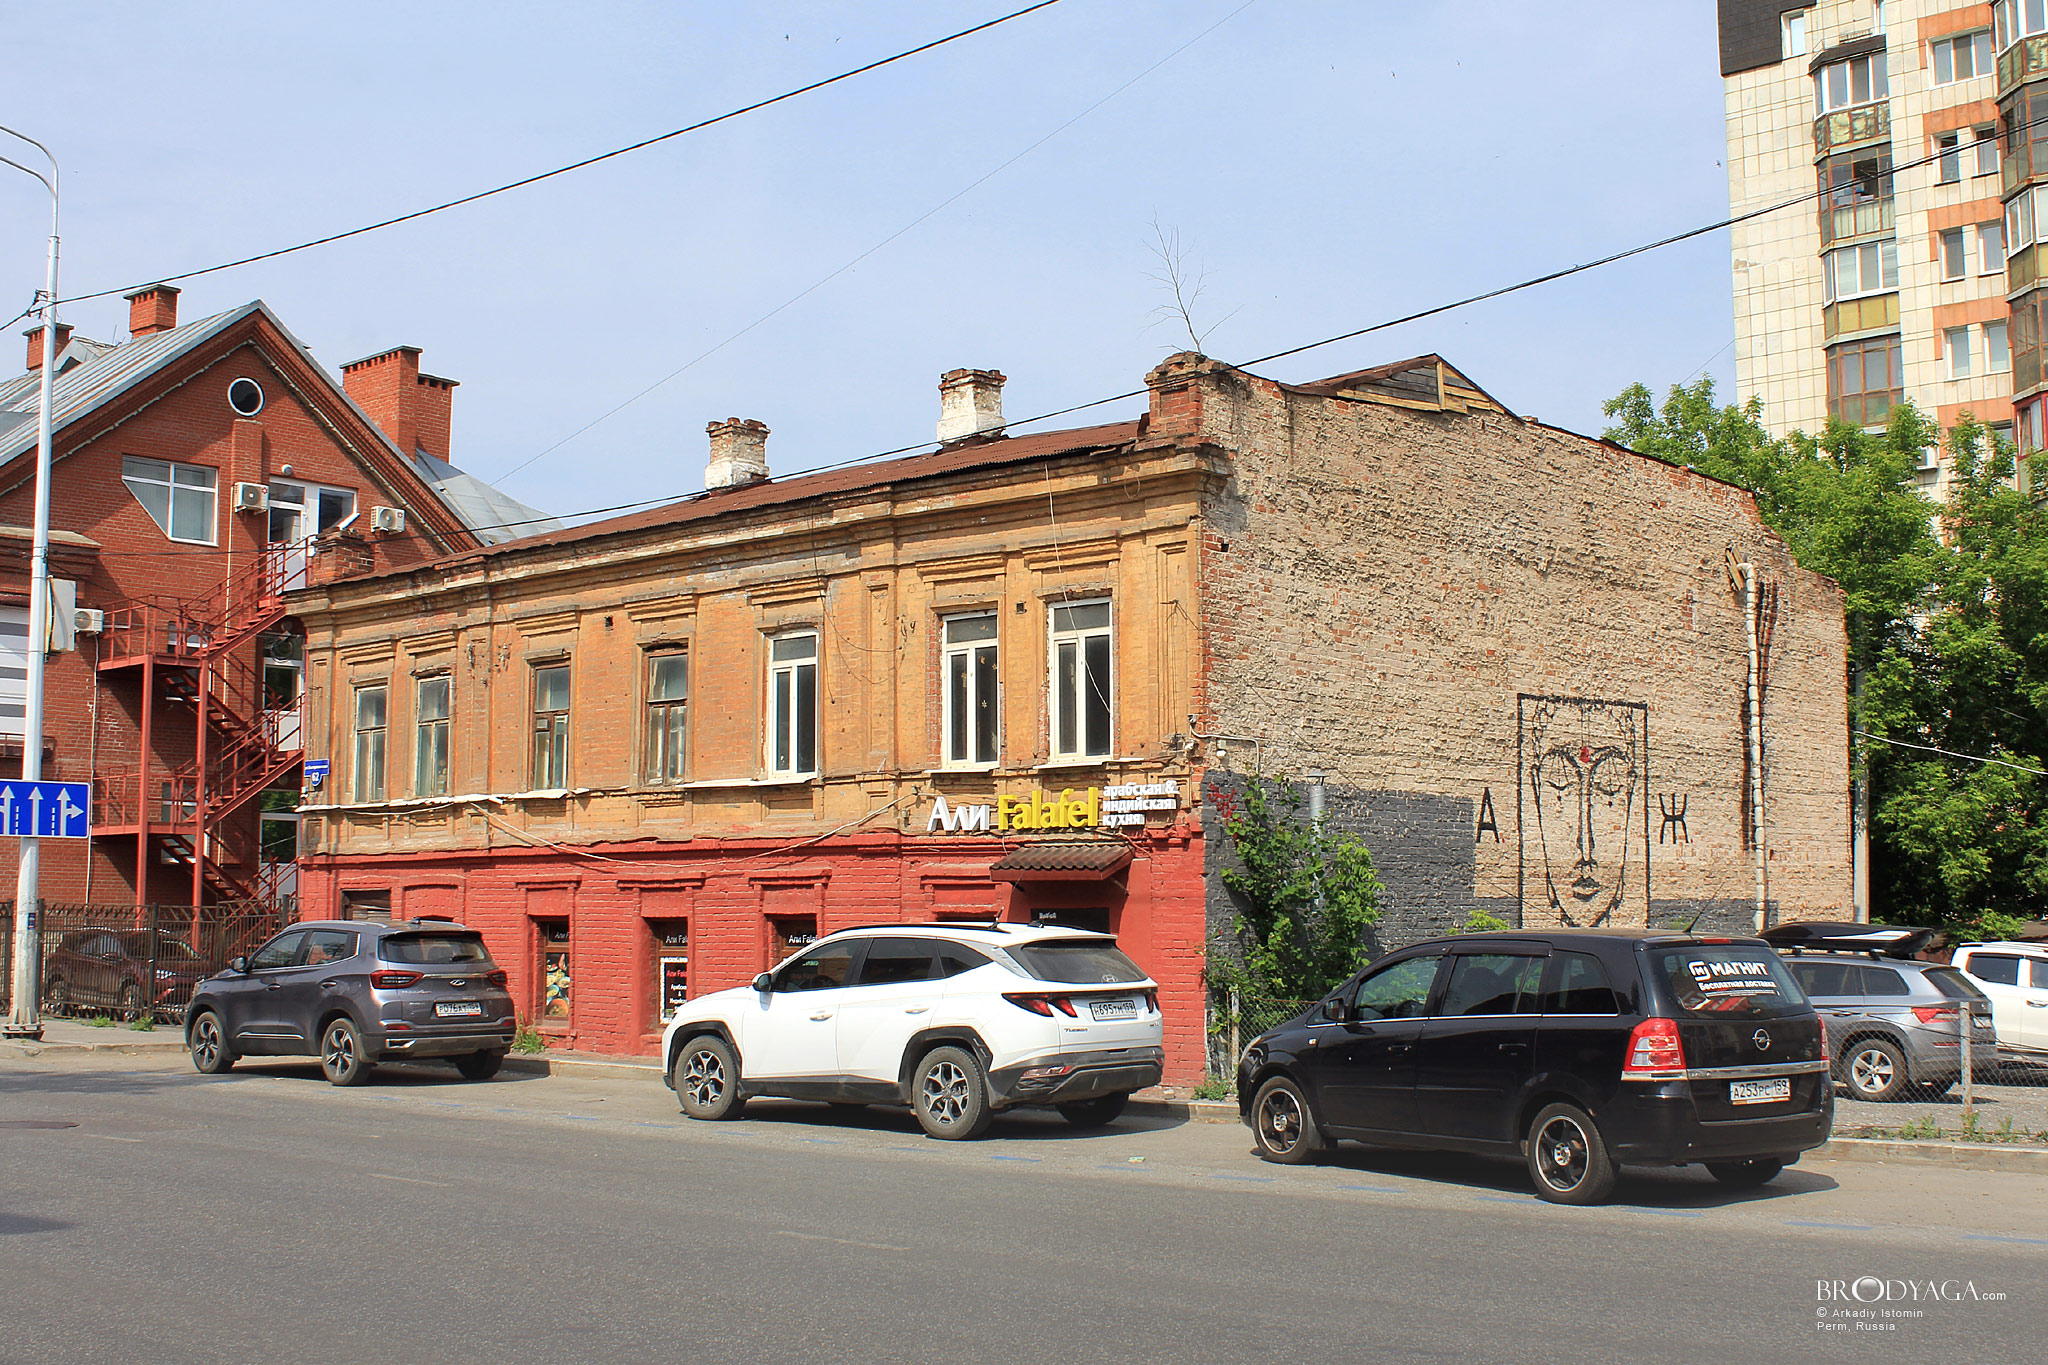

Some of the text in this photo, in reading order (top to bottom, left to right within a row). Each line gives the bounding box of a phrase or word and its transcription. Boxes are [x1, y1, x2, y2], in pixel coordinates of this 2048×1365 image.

[1103, 780, 1180, 800] арабская &
[926, 787, 1098, 831] Али Falafel
[1103, 797, 1177, 813] индийская
[1103, 814, 1145, 829] кухня
[1708, 962, 1768, 976] МАГНИТ
[1697, 980, 1777, 991] Бесплатная доставка
